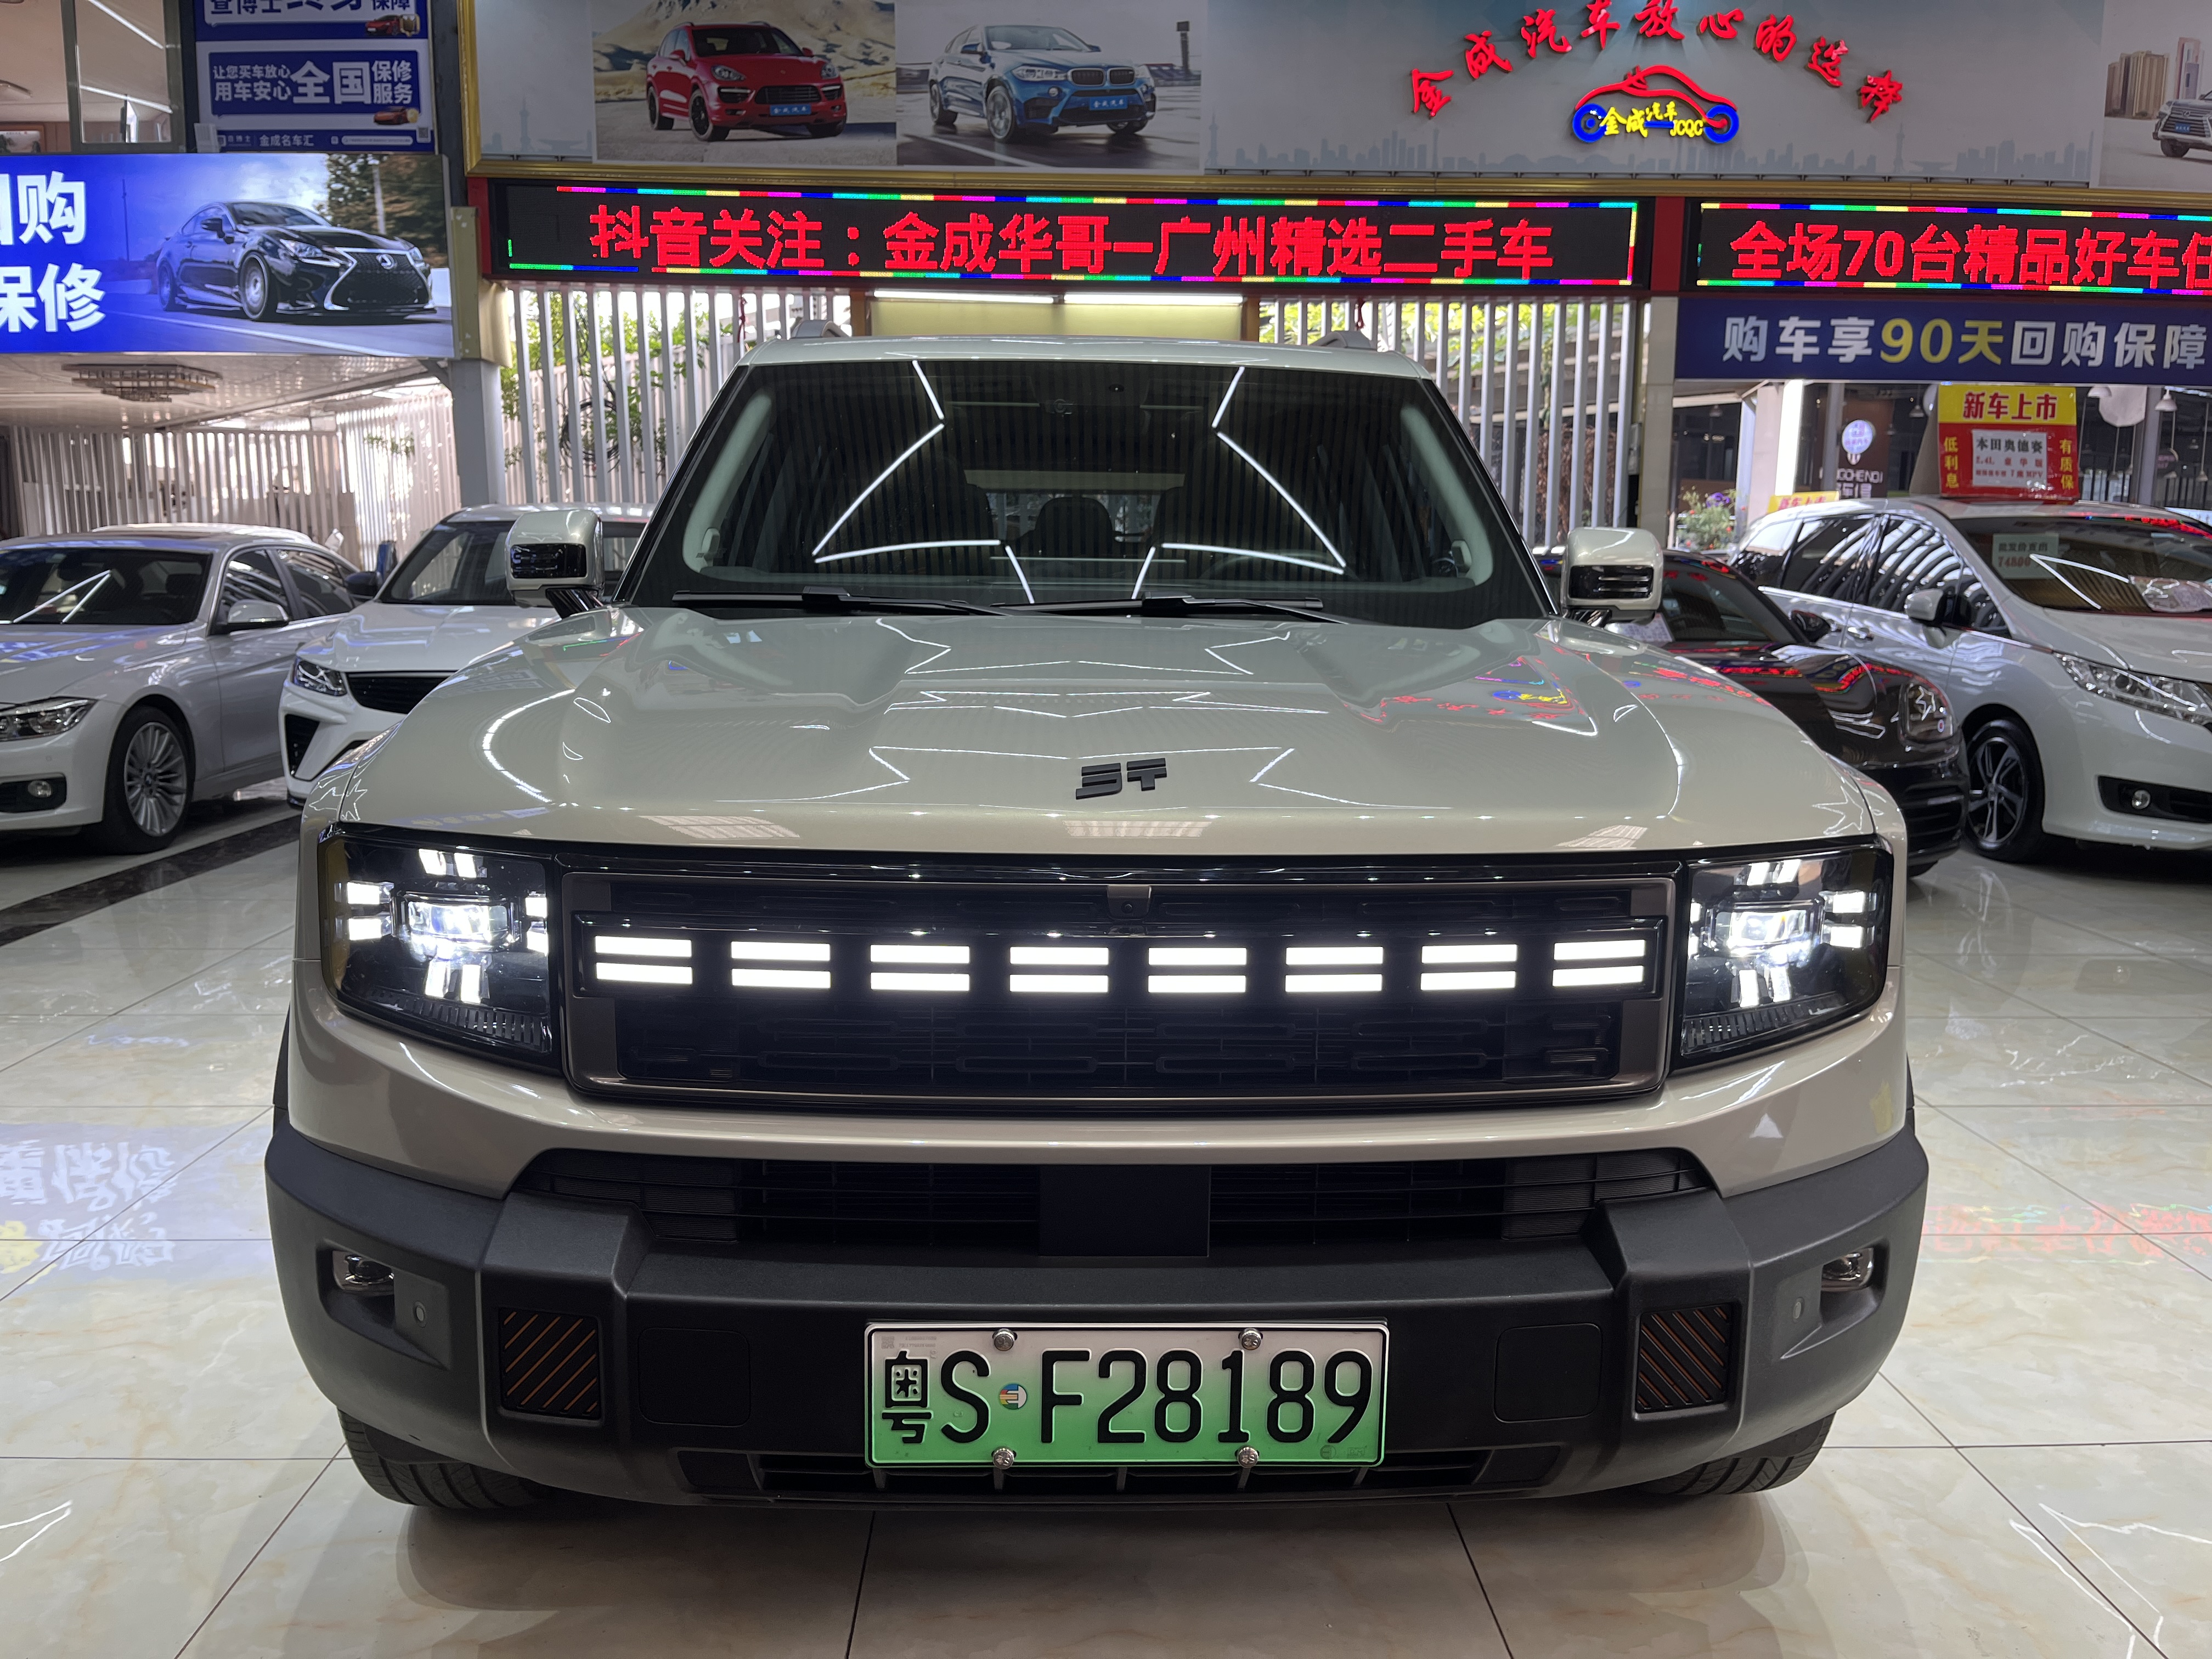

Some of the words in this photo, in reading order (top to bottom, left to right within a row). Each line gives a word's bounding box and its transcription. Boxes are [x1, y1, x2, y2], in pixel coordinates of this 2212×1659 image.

[213, 65, 291, 80] 让您买车放心
[291, 60, 371, 104] 全国
[371, 60, 413, 82] 保修
[215, 81, 292, 101] 用车安心
[373, 83, 413, 104] 服务
[1723, 316, 2207, 369] 购车享90天回购保障
[1963, 391, 2057, 421] 新车上市
